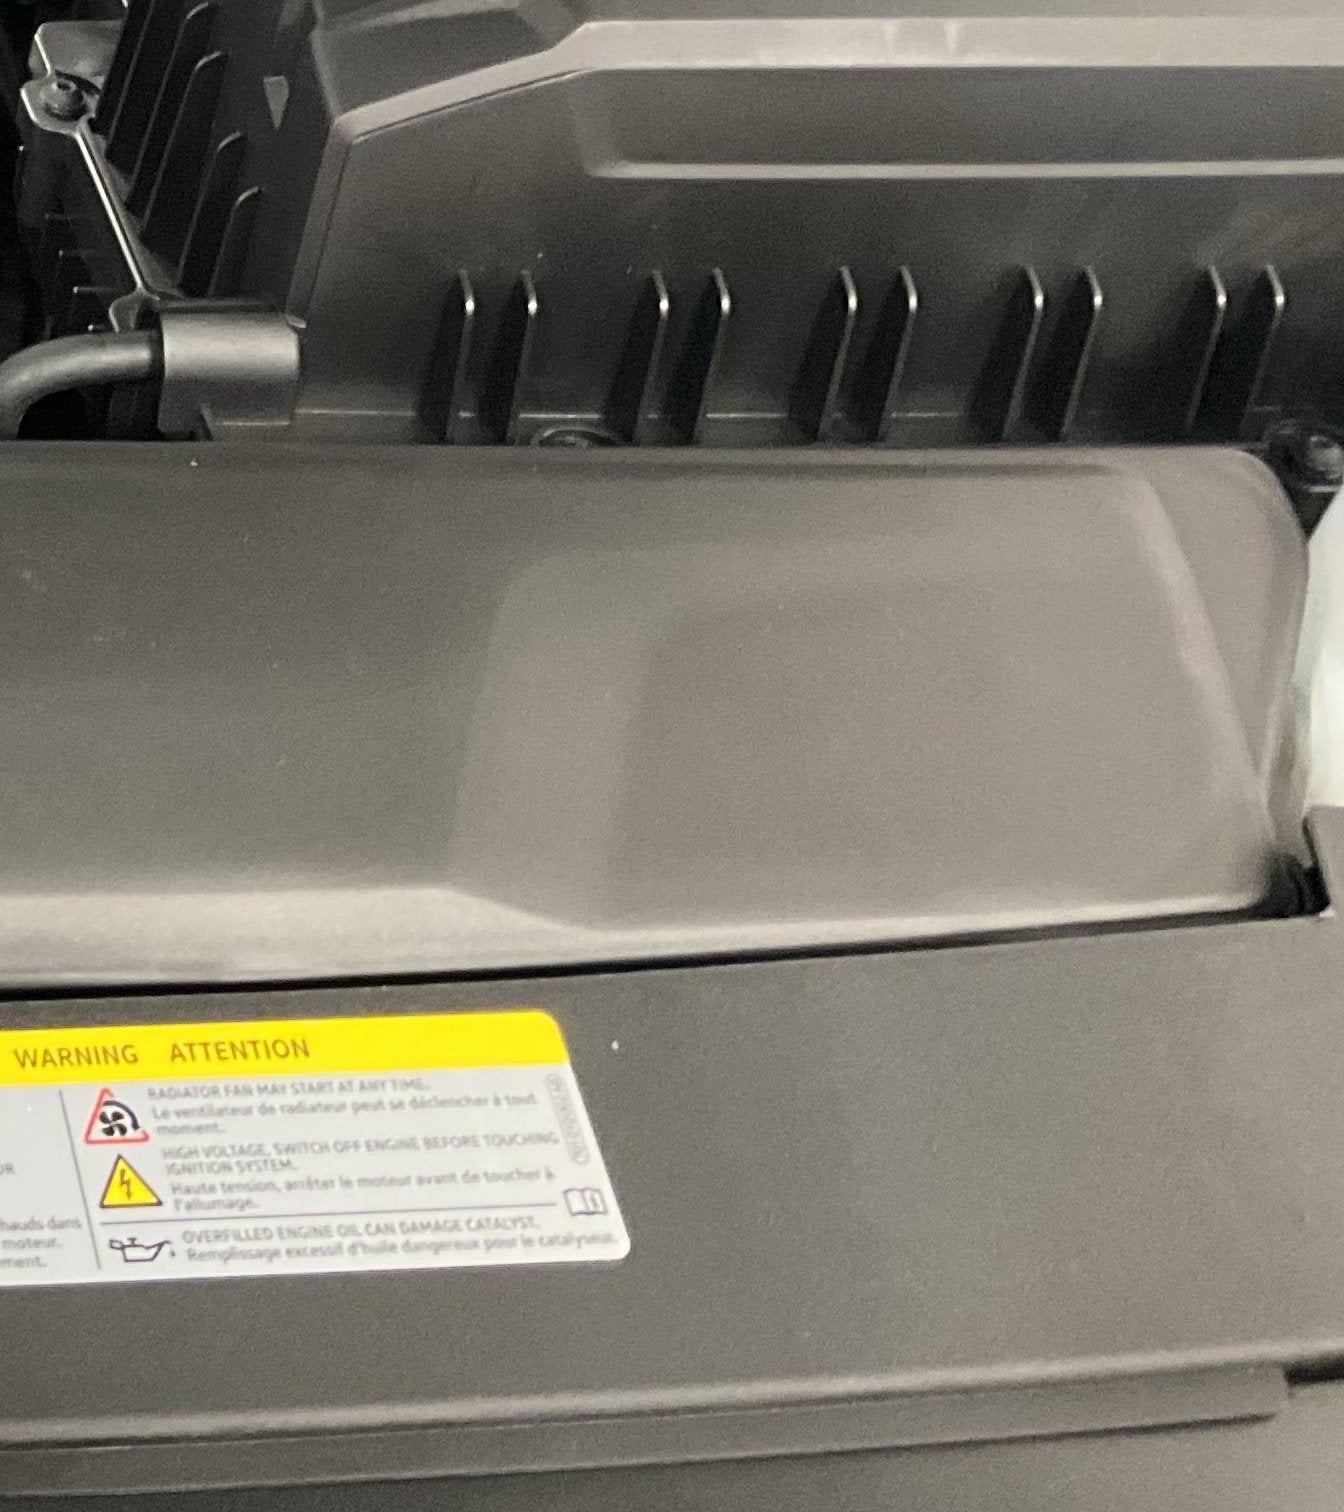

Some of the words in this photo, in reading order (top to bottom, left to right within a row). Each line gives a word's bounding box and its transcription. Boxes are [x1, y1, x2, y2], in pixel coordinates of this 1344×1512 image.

[12, 1044, 139, 1068] WARNING
[170, 1038, 311, 1062] ATTENTION
[148, 1086, 220, 1099] RADIATOR
[225, 1085, 253, 1098] FAN
[256, 1083, 286, 1096] MAY
[290, 1081, 333, 1095] START
